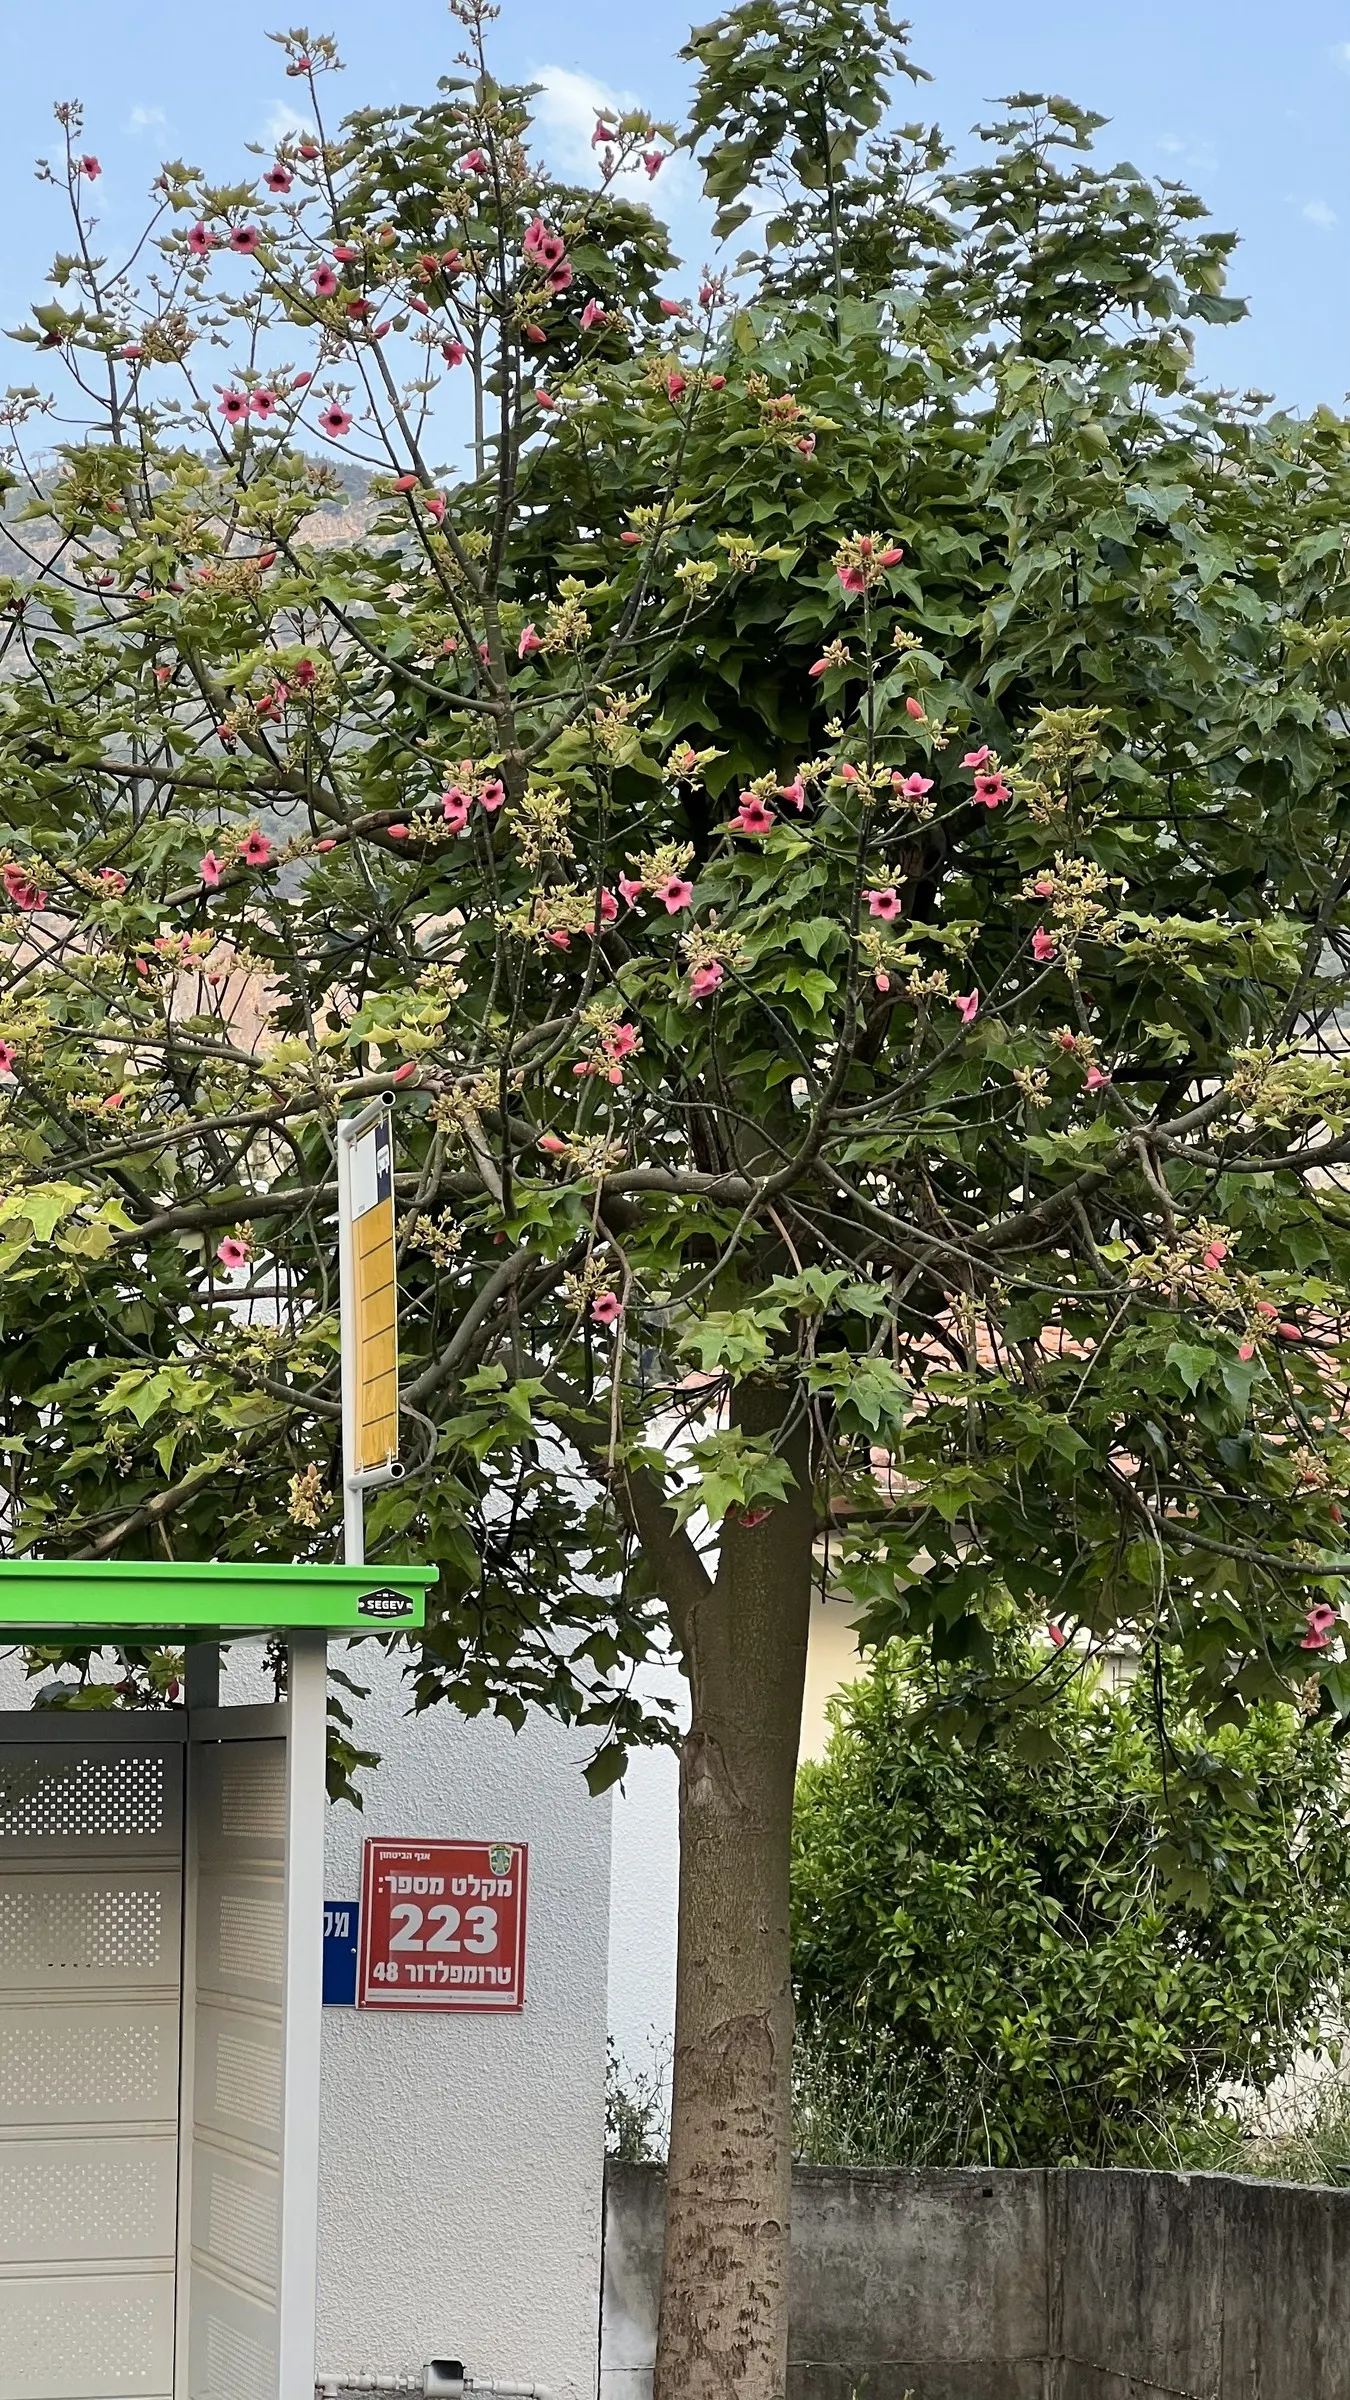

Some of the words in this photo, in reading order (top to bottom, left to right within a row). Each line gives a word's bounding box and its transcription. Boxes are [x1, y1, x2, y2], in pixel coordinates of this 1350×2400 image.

[367, 1600, 405, 1610] SEGEV
[379, 1851, 413, 1861] הביטחון
[378, 1876, 445, 1895] מספר:
[452, 1874, 512, 1901] מקלט
[389, 1903, 498, 1955] 223
[373, 1962, 399, 1983] 48
[405, 1961, 511, 1985] טרומפלדור
